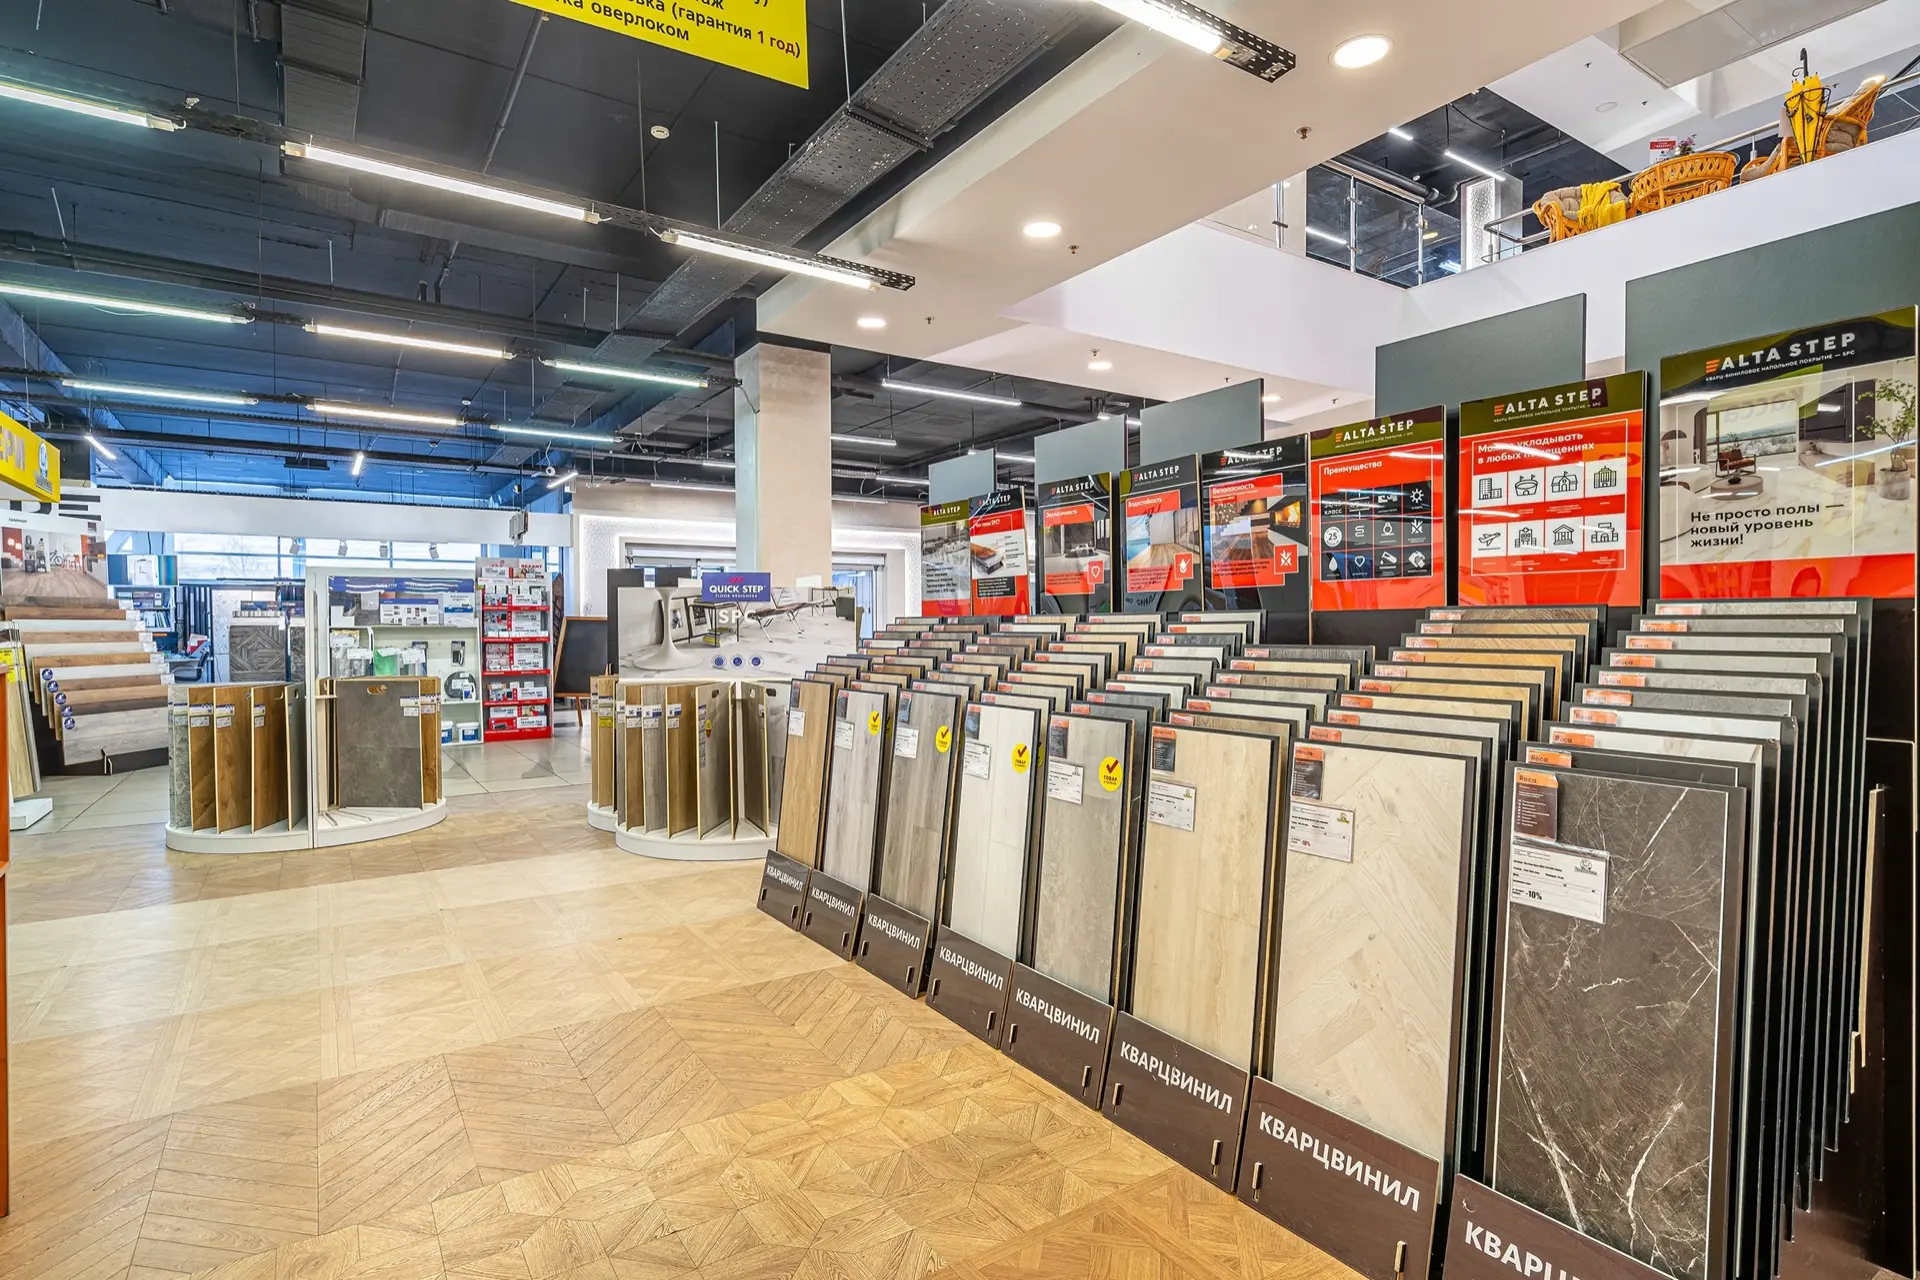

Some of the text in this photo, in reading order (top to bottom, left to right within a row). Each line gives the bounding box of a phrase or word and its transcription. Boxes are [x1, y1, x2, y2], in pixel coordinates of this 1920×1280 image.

[591, 2, 690, 41] оверлоком
[672, 2, 752, 40] (гарантия
[757, 31, 764, 44] 1
[770, 36, 801, 58] год)
[1720, 333, 1855, 371] ALTA STEP
[1705, 367, 1761, 382] КВАРЦ-ВИНИЛОВОЕ
[1761, 360, 1798, 372] НАПОЛЬНОЕ
[1799, 354, 1833, 365] ПОКРЫТИЕ
[1505, 388, 1602, 414] ALTA STEP
[1343, 420, 1414, 441] ALTA STEP
[1516, 433, 1583, 448] укладывать
[1486, 451, 1521, 463] любых
[1524, 442, 1595, 459] пещениях
[1138, 470, 1158, 481] ALTA
[1159, 465, 1180, 477] STEP
[1323, 461, 1382, 477] Преимущества
[1055, 482, 1094, 494] ALTA STEP
[1212, 483, 1255, 494] Безопасность
[932, 505, 961, 517] ALTA STEP
[1690, 511, 1710, 523] Не
[1715, 509, 1770, 522] просто
[1776, 504, 1820, 516] полы
[1690, 517, 1814, 535] новый уровень
[1328, 532, 1338, 541] 25
[1690, 533, 1743, 548] жизни!
[709, 584, 764, 594] QUICK STEP
[718, 609, 757, 624] SPC
[1530, 754, 1549, 763] Roca
[1519, 775, 1537, 784] Roca
[766, 864, 804, 893] КВАРЦВИНИЛ
[811, 887, 856, 918] КВАРЦВИНИЛ
[1525, 890, 1543, 900] -10%
[867, 913, 921, 950] КВАРЦВИНИЛ
[939, 946, 1004, 991] КВАРЦВИНИЛ
[1015, 988, 1100, 1045] КВАРЦВИНИЛ
[1120, 1041, 1233, 1115] КВАРЦВИНИЛ
[1259, 1111, 1421, 1213] КВАРЦВИНИЛ
[1465, 1220, 1580, 1280] КВАРЦ
